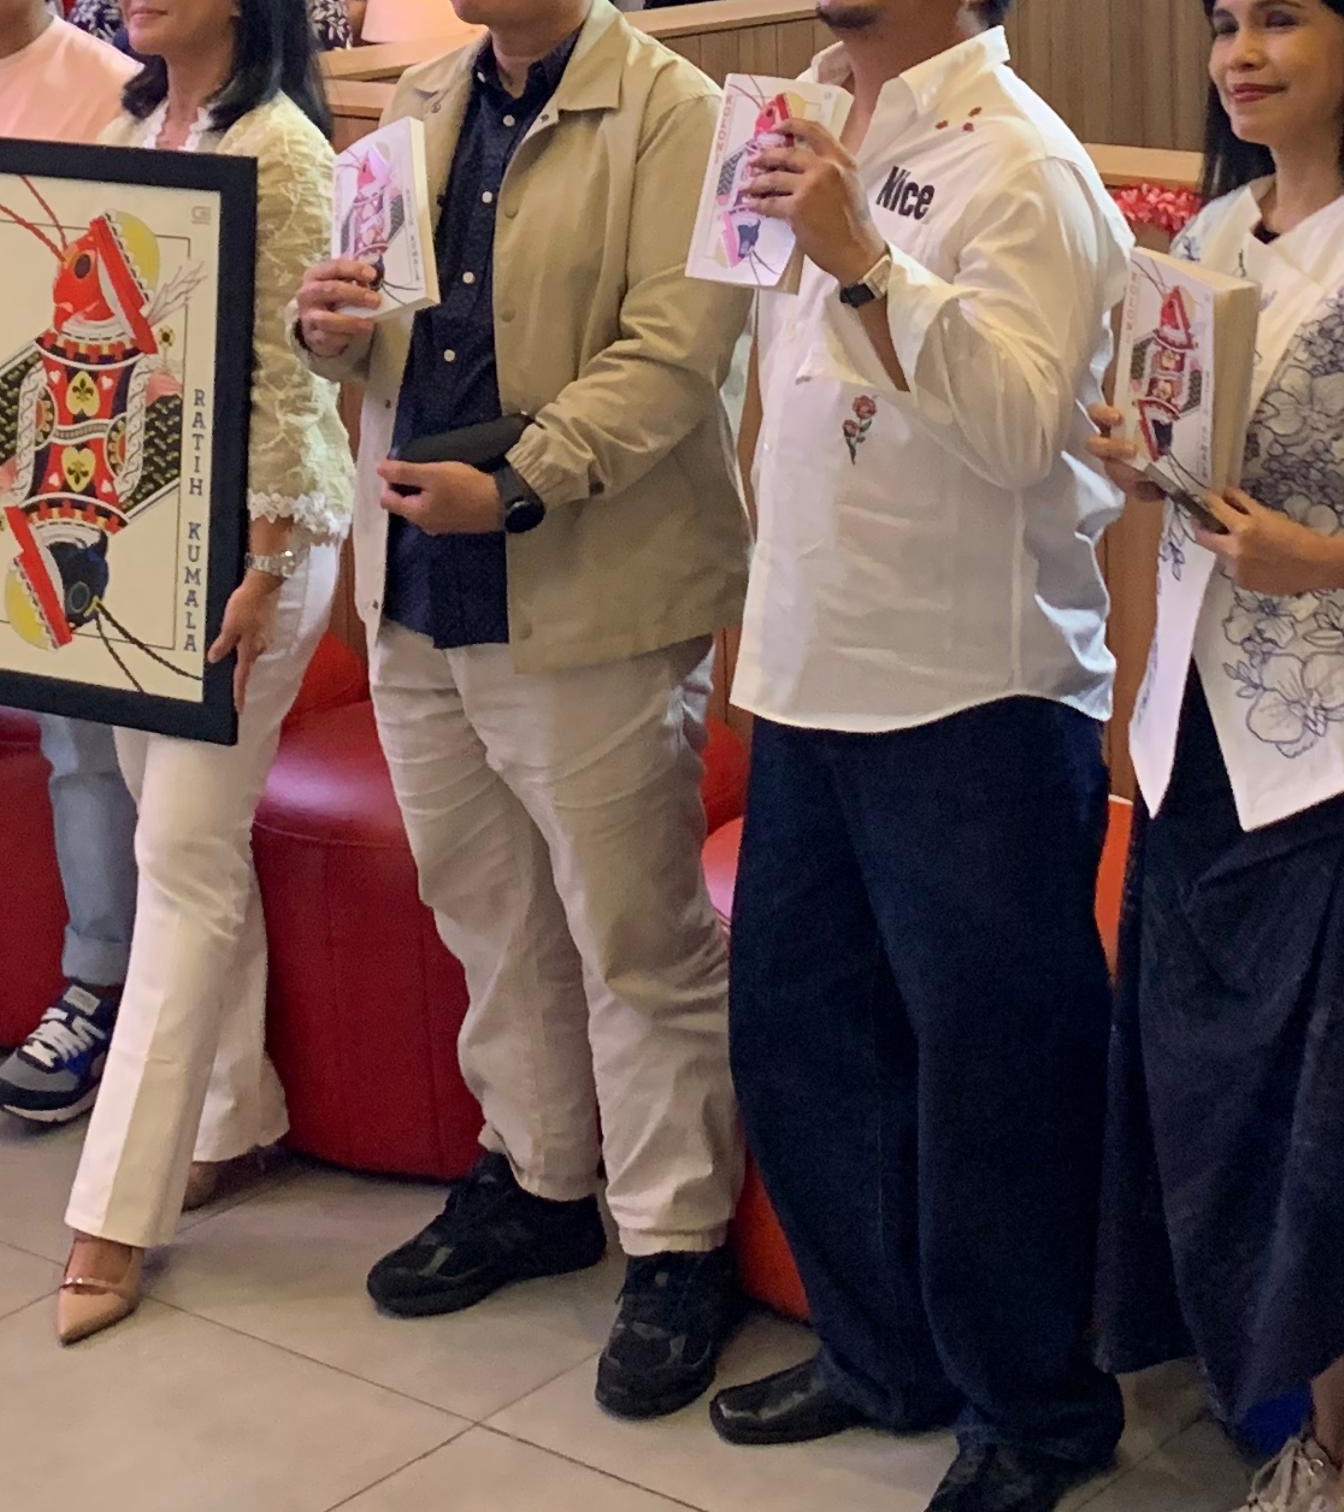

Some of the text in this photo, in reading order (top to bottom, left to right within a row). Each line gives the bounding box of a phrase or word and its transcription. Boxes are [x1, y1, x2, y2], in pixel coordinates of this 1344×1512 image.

[875, 165, 935, 221] Nice
[183, 388, 206, 653] RATIH KUMALA
